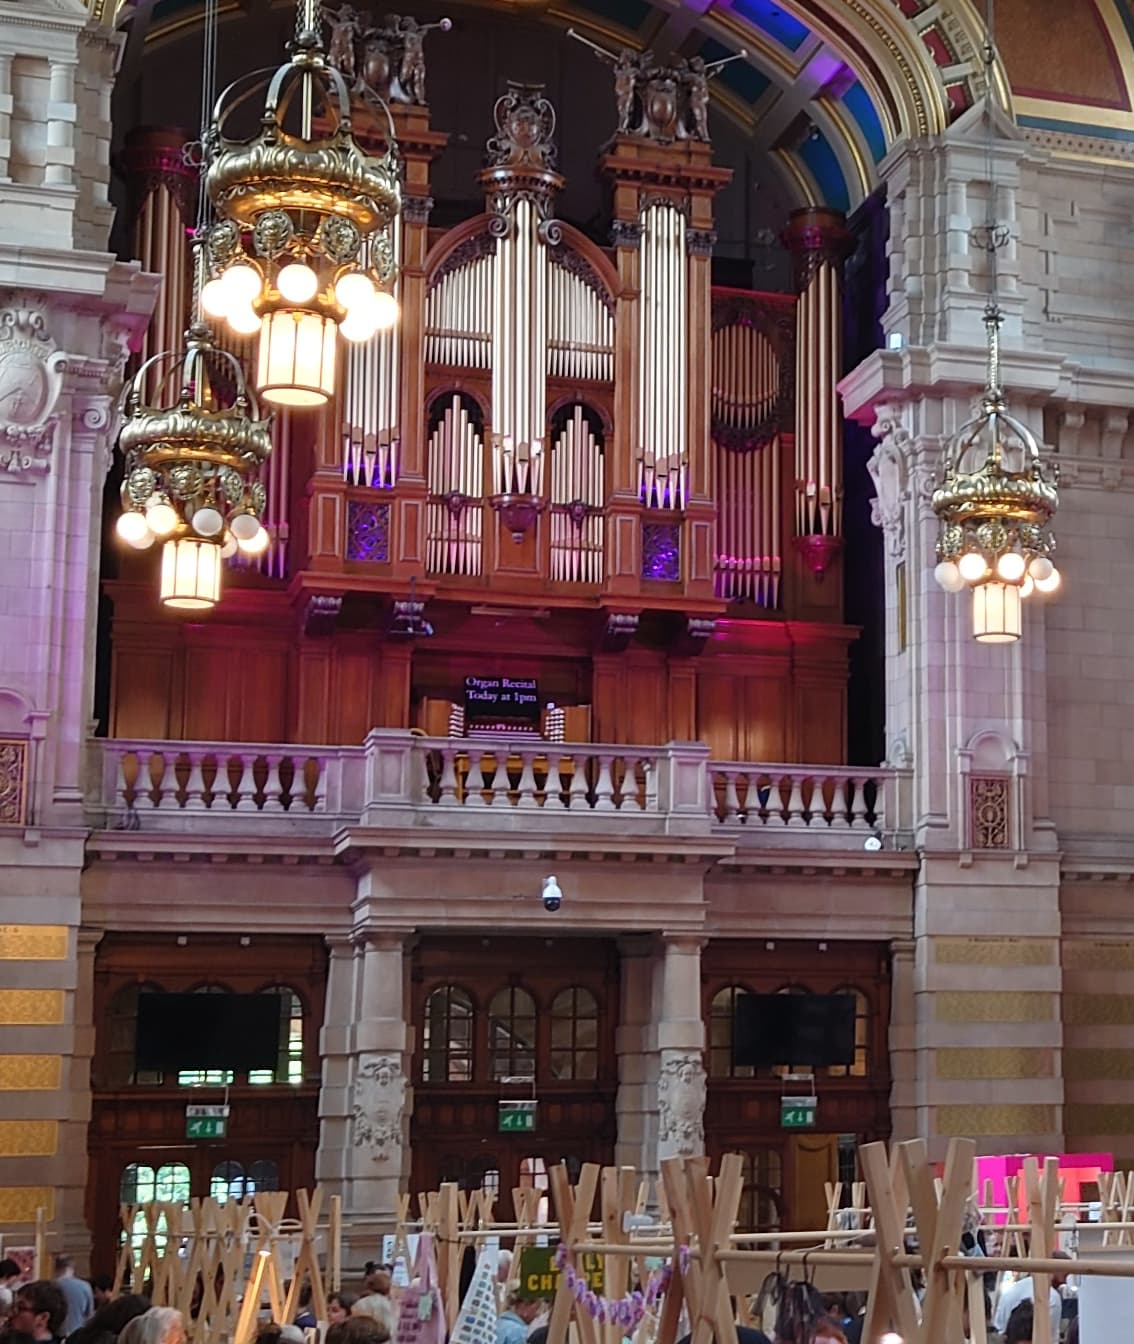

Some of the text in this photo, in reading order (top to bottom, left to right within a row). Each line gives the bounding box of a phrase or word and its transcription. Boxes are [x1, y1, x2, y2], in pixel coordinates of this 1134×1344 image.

[466, 677, 536, 689] Organ Recital
[466, 689, 537, 704] Today at 1pm
[549, 1253, 604, 1271] ELY
